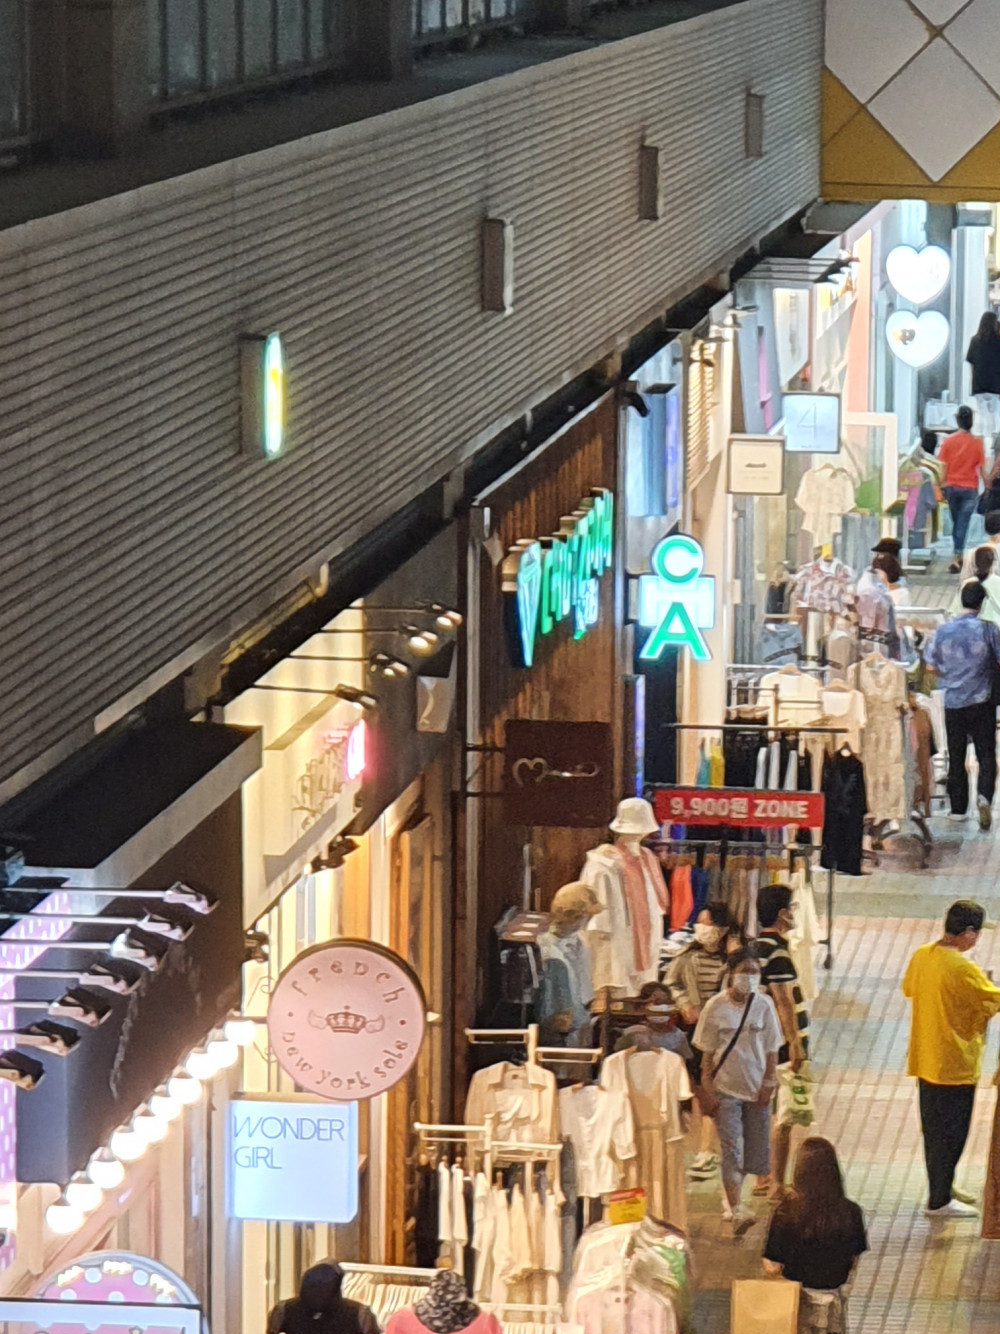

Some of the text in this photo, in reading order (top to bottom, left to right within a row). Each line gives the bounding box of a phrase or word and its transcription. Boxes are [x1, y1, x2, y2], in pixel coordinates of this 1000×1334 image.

[753, 799, 809, 818] ZONE
[315, 1069, 371, 1090] york
[233, 1115, 345, 1142] WONDER
[233, 1146, 283, 1170] GIRL
